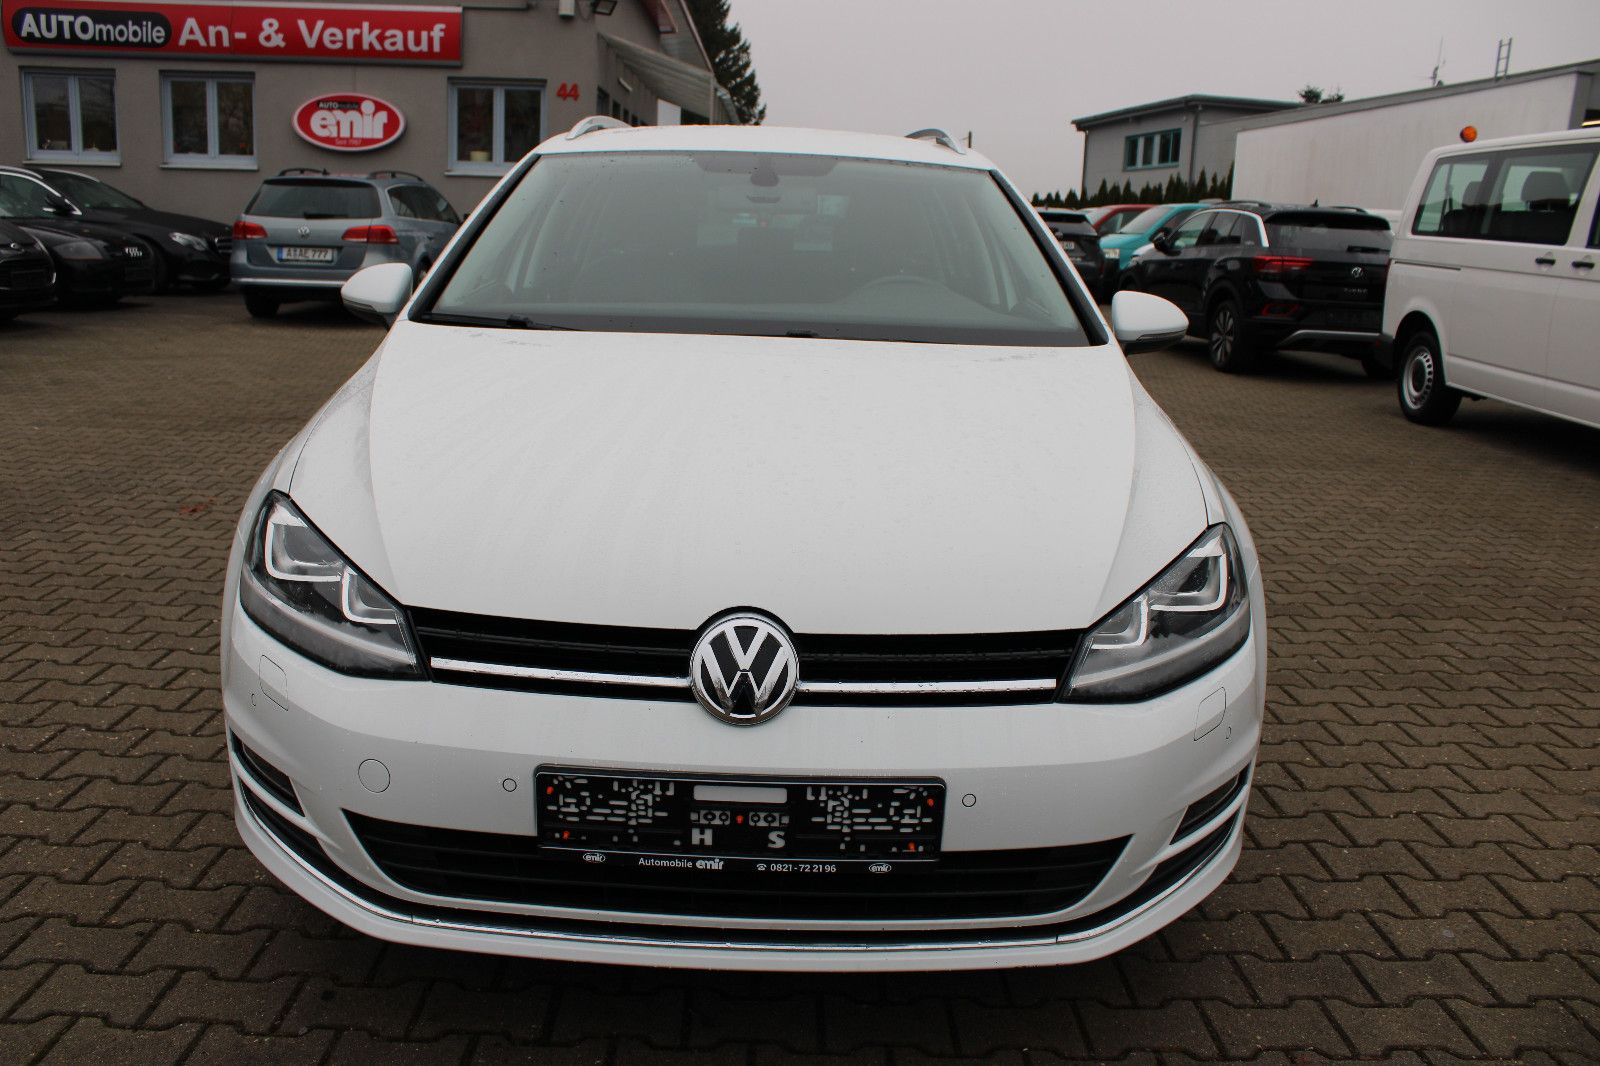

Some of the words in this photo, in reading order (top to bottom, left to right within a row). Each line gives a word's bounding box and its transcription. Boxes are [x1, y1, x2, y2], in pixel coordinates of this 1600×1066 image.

[21, 13, 166, 43] AUTOmobile
[178, 17, 247, 48] An-
[258, 18, 286, 48] &
[297, 19, 446, 53] Verkauf
[556, 81, 580, 101] 44
[310, 100, 388, 139] emir
[585, 853, 603, 862] emir
[638, 857, 693, 868] Automobile
[695, 858, 724, 870] emir
